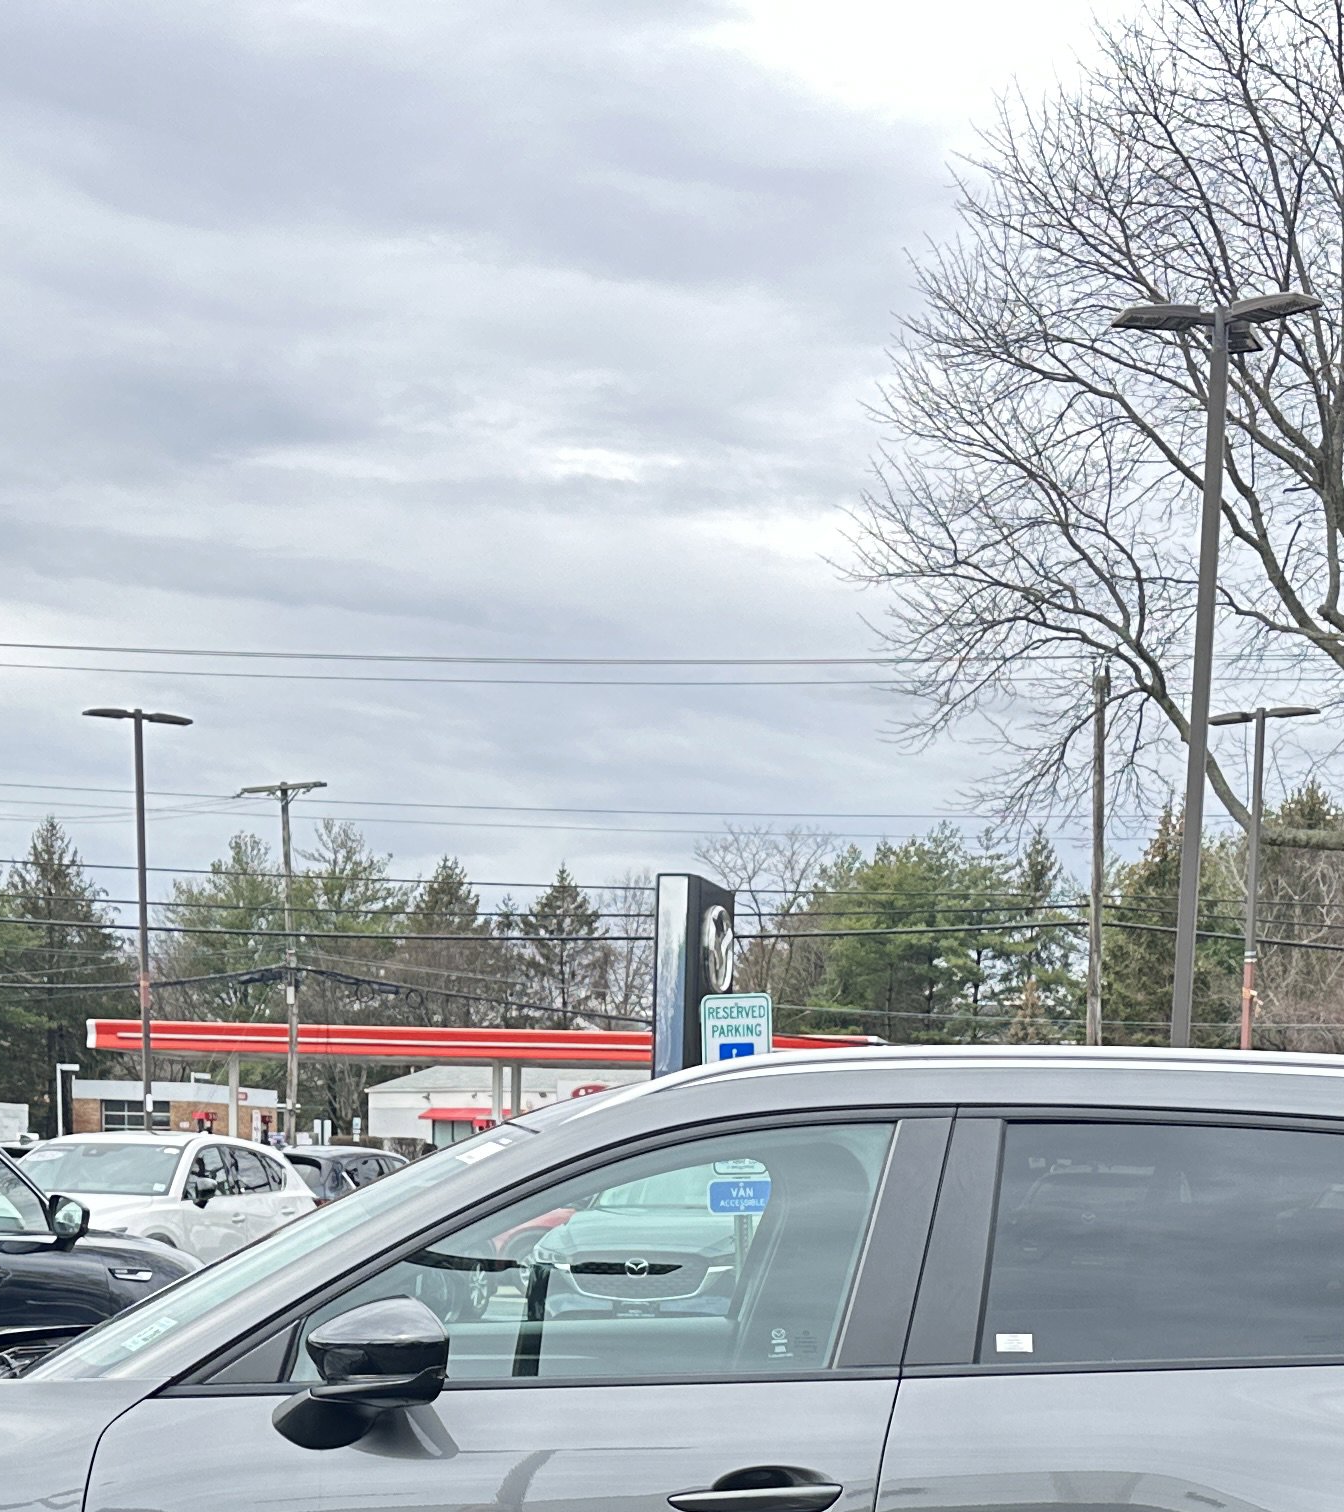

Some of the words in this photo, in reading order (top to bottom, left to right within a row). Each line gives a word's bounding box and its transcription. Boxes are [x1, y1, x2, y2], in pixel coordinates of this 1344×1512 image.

[707, 1005, 766, 1020] RESERVED
[711, 1024, 762, 1038] PARKING
[730, 1187, 754, 1198] VAN
[719, 1199, 765, 1207] ACCESSIBLE
